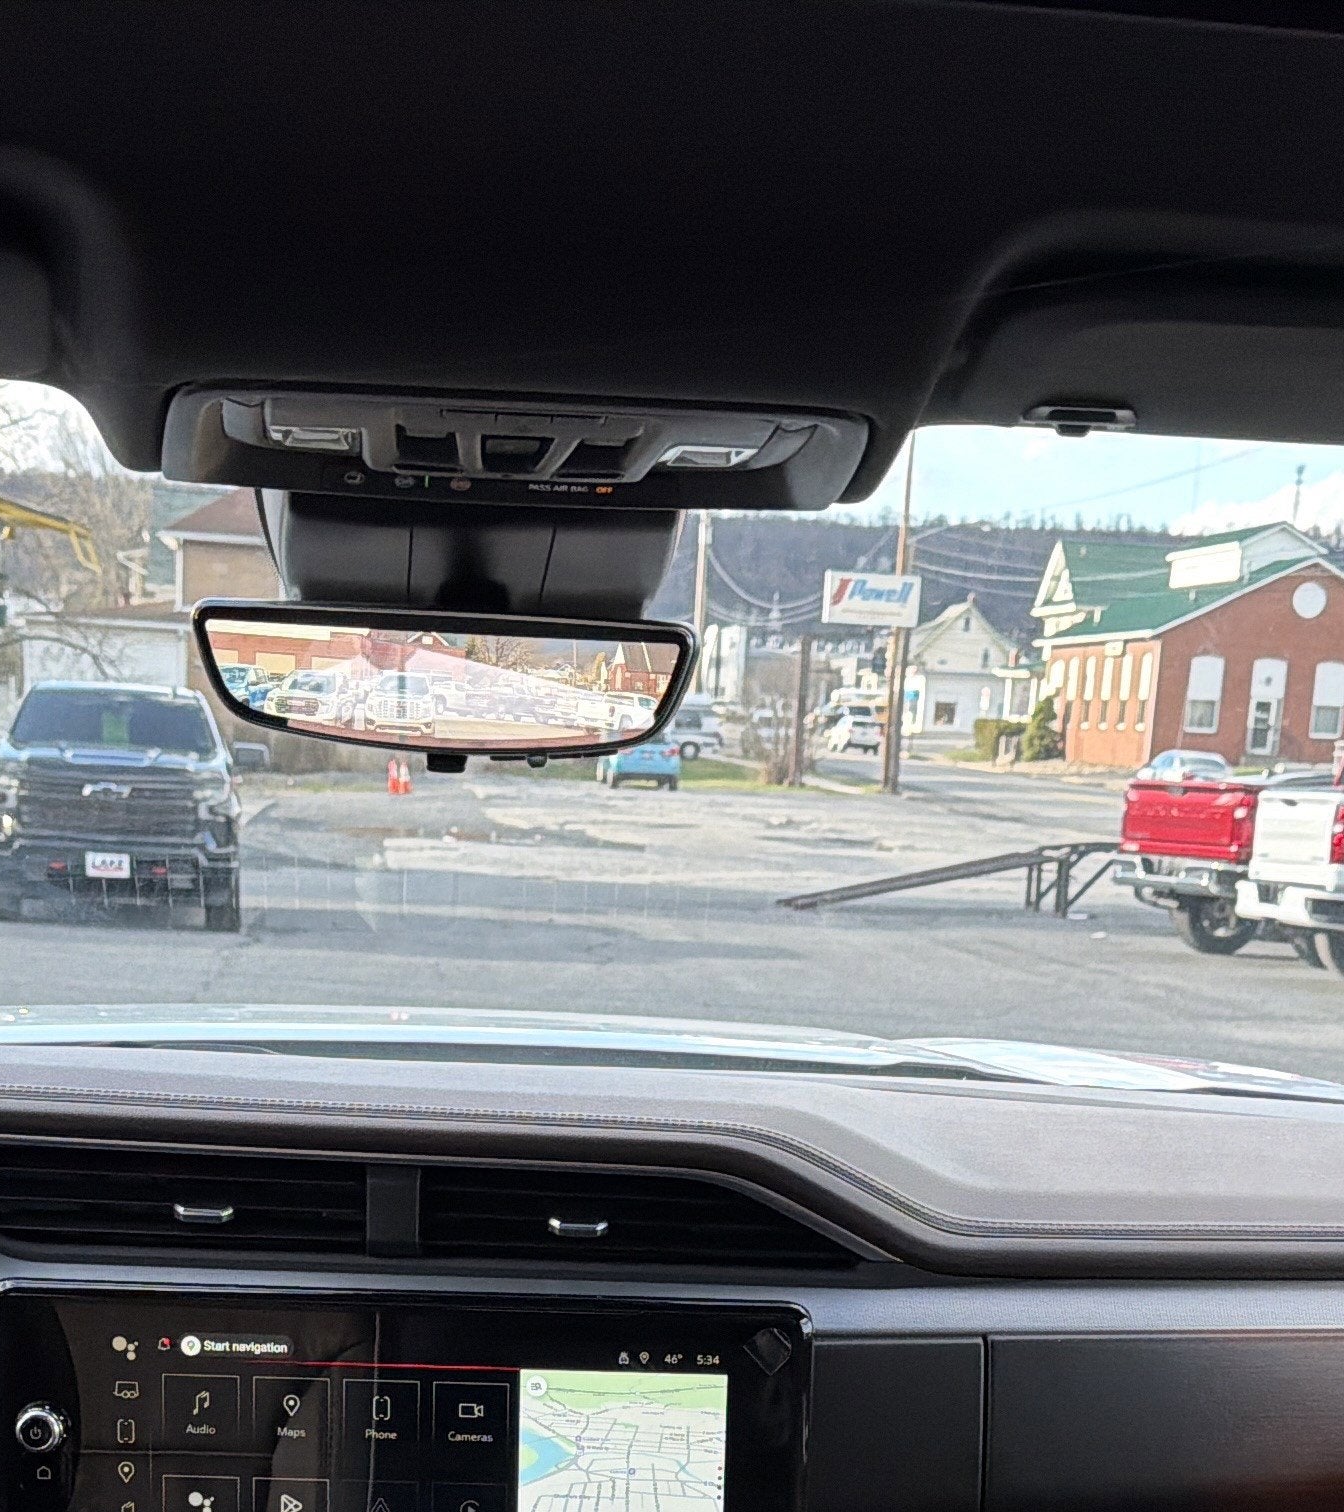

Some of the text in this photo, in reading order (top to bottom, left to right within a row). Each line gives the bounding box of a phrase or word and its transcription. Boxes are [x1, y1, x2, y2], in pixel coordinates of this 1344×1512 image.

[528, 483, 614, 494] PASS AIR BAG OFF
[847, 579, 914, 608] Powell
[203, 1340, 288, 1356] Start navigation
[664, 1354, 720, 1366] 46° 5:34
[186, 1424, 216, 1436] Audio
[277, 1426, 306, 1440] Maps
[365, 1429, 397, 1440] Phone
[448, 1430, 494, 1443] Cameras
